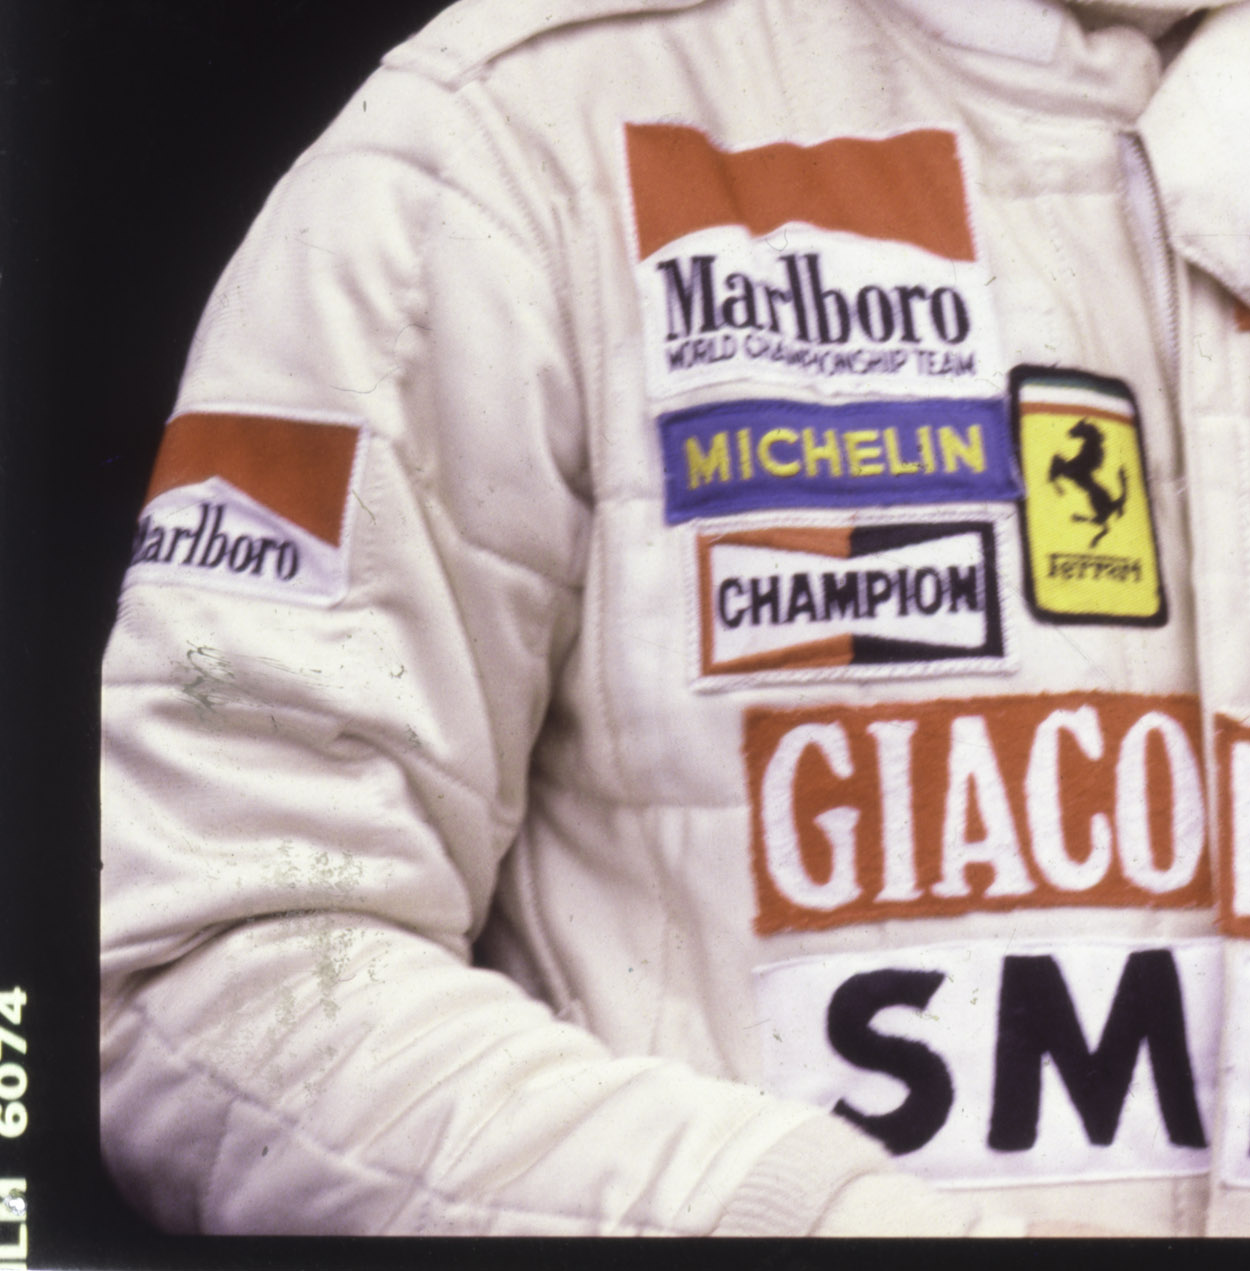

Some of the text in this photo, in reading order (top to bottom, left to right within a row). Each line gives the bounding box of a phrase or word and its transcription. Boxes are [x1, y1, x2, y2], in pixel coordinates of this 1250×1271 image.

[656, 253, 971, 345] Marlboro
[665, 334, 976, 376] WORLD CHAMPIONSHIP TEAM
[684, 424, 986, 490] MICHELIN
[718, 564, 984, 629] CHAMPION
[0, 986, 28, 1138] 6074
